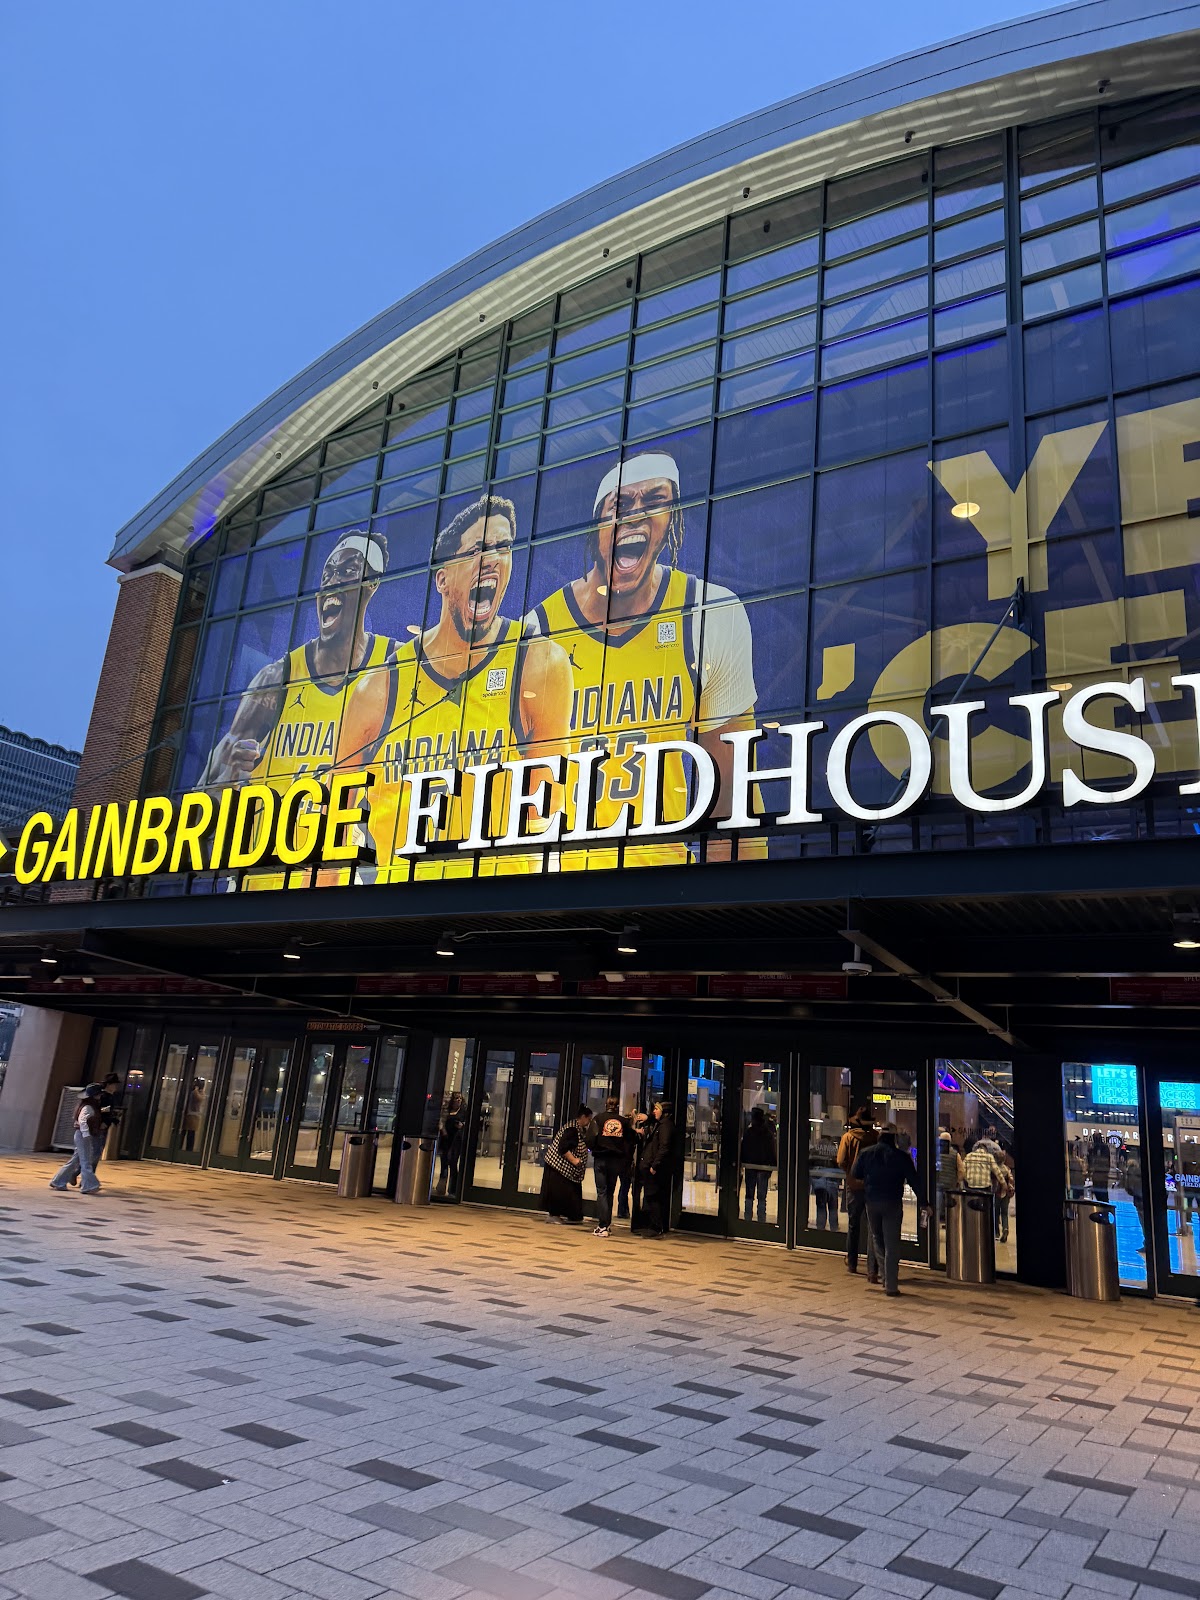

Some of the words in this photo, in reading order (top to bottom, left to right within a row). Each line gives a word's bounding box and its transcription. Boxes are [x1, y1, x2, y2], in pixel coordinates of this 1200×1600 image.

[384, 728, 505, 784] INDIANA
[15, 771, 370, 884] GAINBRIDGE
[1097, 1068, 1127, 1078] LET'S
